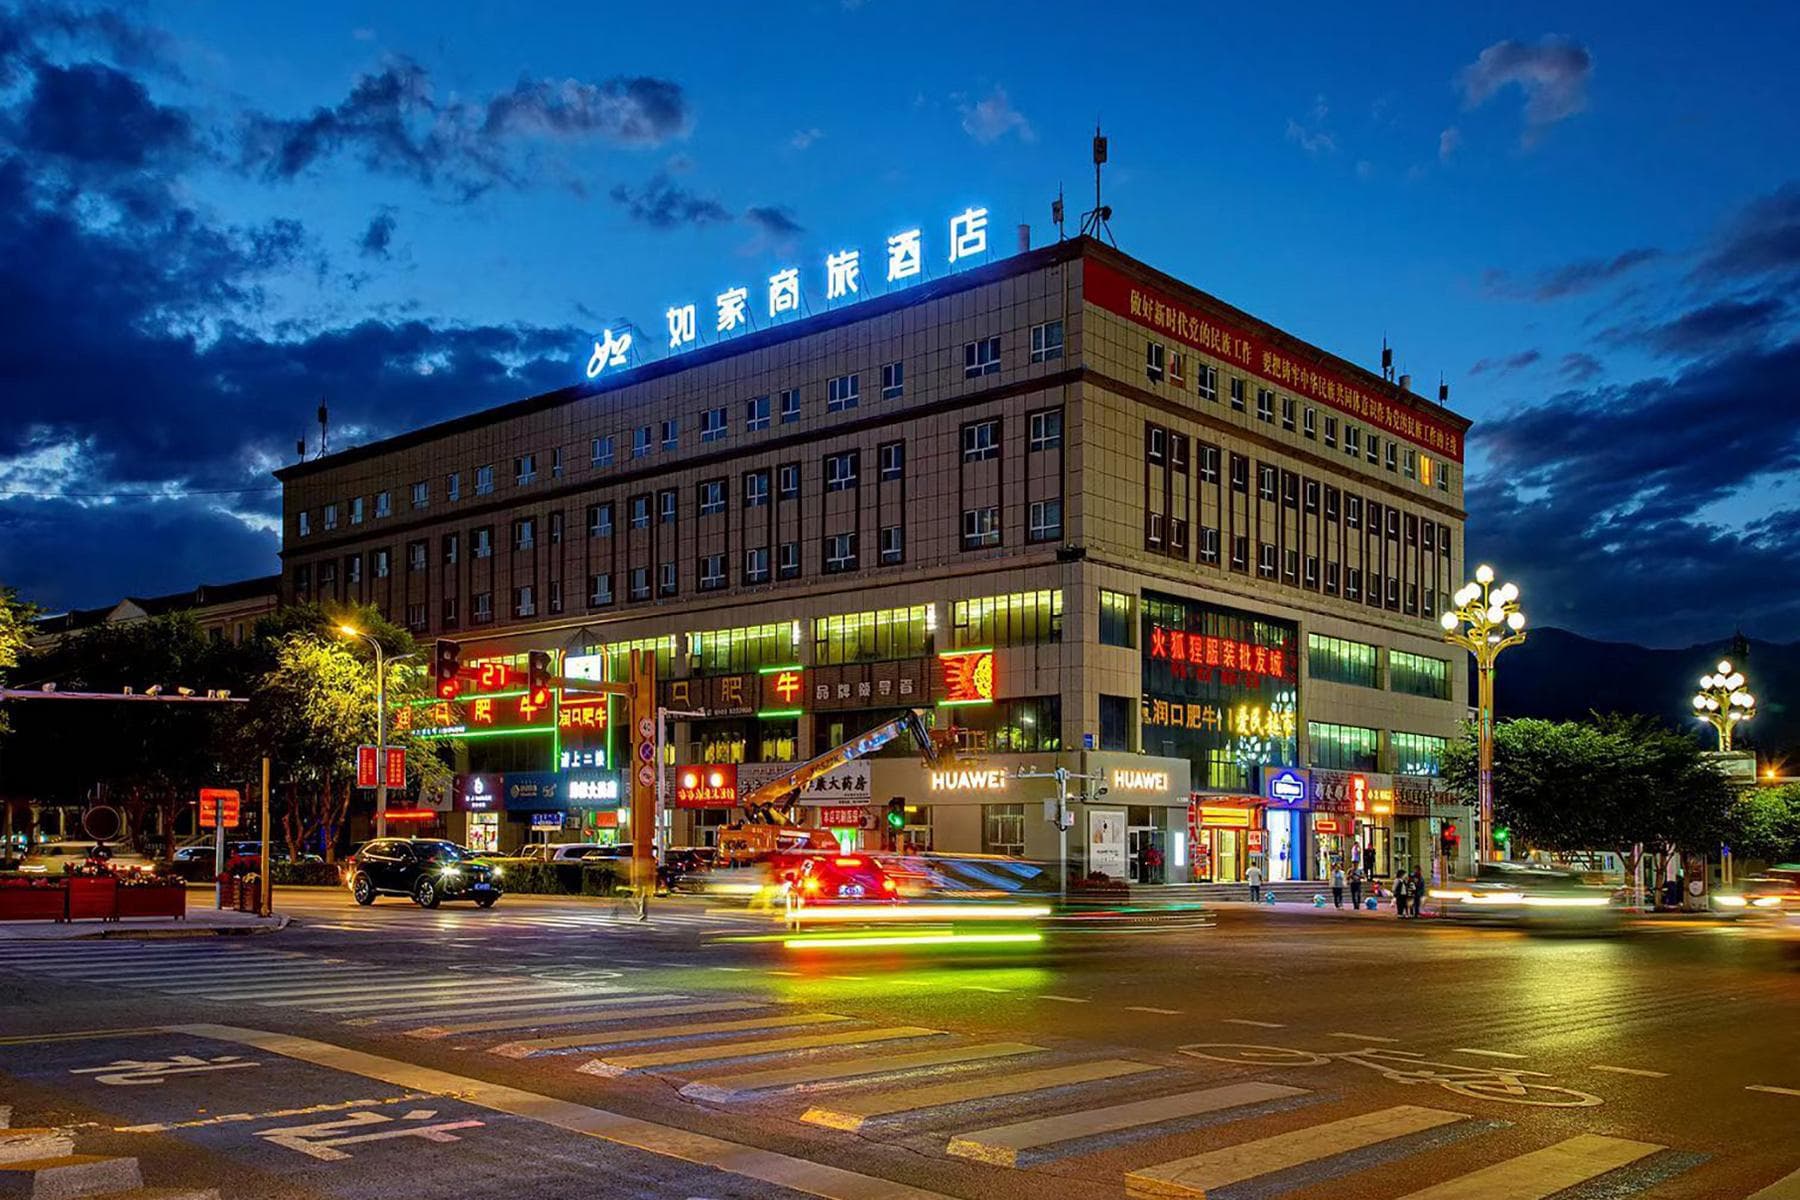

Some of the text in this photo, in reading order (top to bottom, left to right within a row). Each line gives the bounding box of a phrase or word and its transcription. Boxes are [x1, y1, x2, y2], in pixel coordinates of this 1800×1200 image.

[666, 206, 989, 349] 如家商旅酒店
[1130, 288, 1253, 366] 做好新时代党的民族工作
[1151, 625, 1284, 678] 火狐狸服装批发城
[482, 663, 506, 686] 27
[559, 707, 607, 728] 润口肥牛
[1152, 698, 1217, 732] 润口肥牛
[931, 770, 1006, 791] HUAWEI
[1113, 769, 1169, 791] HUAWEI
